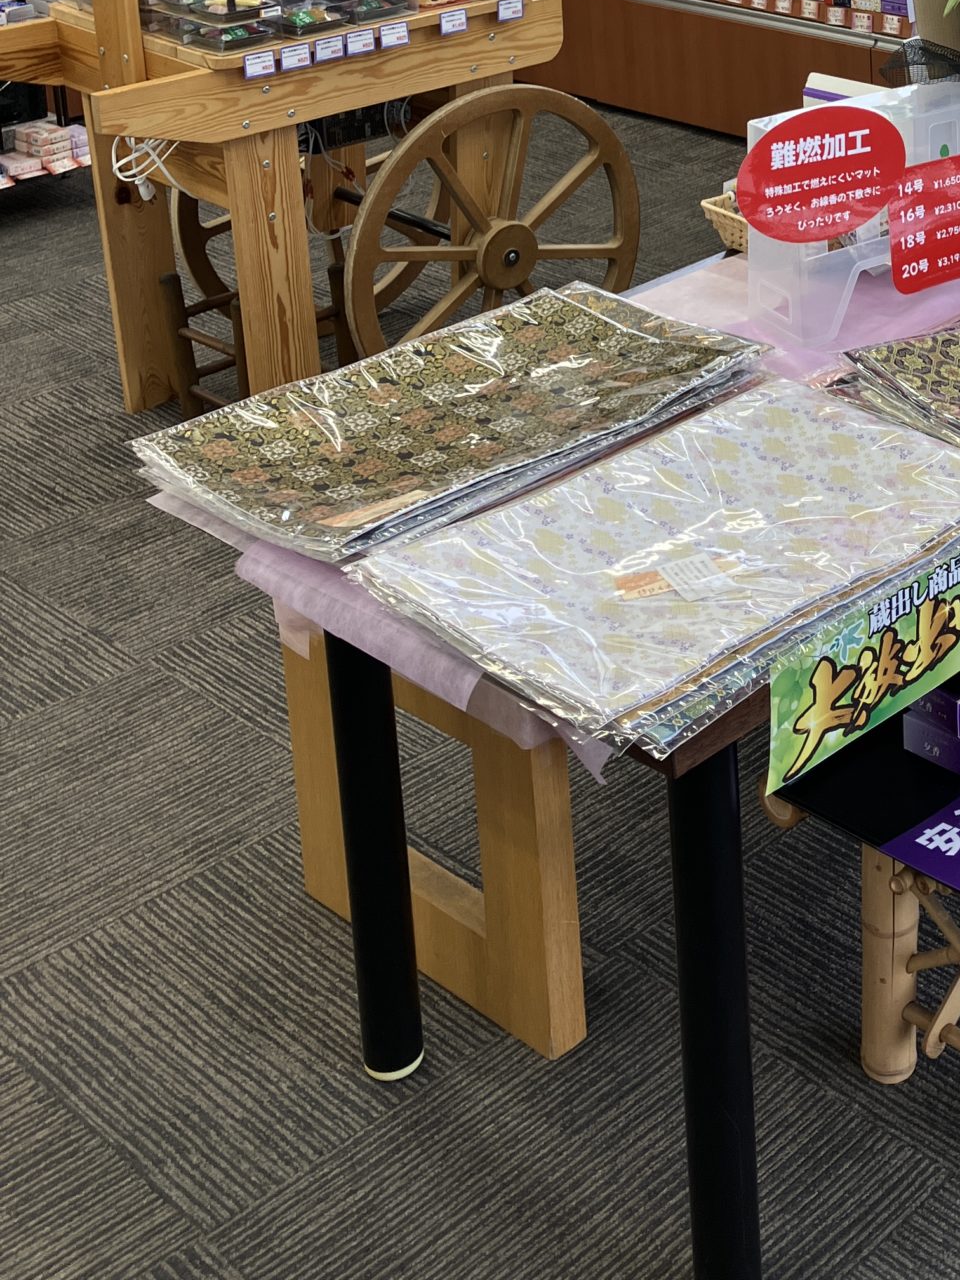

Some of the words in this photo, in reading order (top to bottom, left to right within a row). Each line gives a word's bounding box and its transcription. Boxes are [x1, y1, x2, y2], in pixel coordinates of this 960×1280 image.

[770, 128, 872, 171] 難燃加工
[764, 166, 881, 199] 特殊加工で燃えにくいマット
[897, 178, 925, 198] 14号
[765, 186, 881, 219] ろうそく、お線香の下敷きに
[797, 210, 851, 231] ぴったりです
[899, 205, 926, 224] 16号
[900, 231, 926, 251] 18号
[901, 258, 930, 279] 20号
